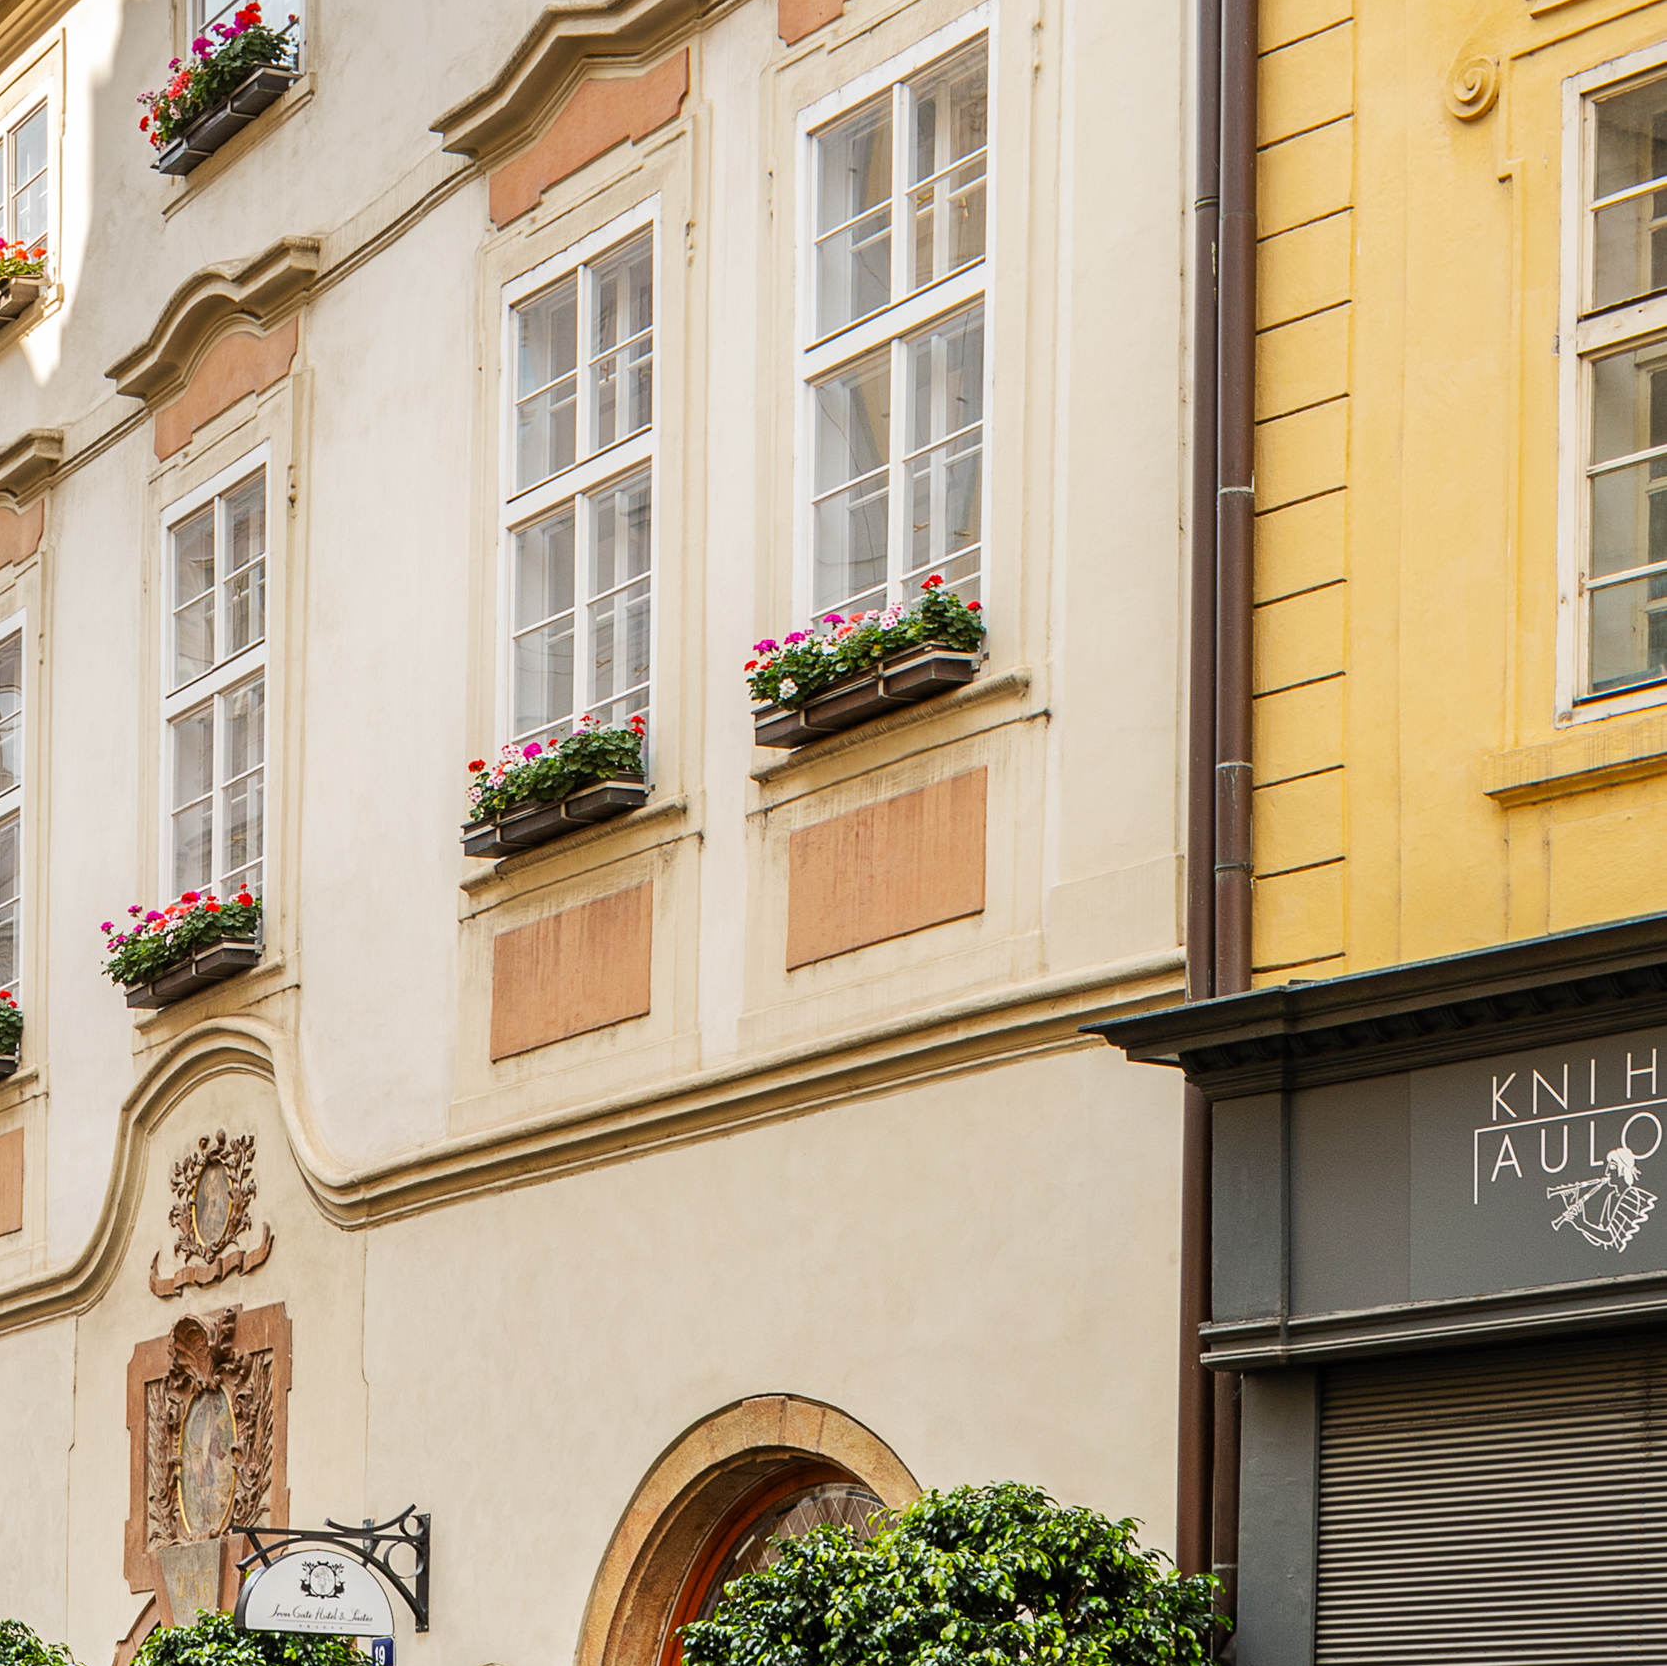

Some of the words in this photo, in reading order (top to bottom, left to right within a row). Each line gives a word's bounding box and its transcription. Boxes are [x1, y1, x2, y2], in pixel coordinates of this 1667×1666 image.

[1491, 1047, 1658, 1121] KNIH
[1490, 1112, 1663, 1183] AULO
[269, 1604, 291, 1618] Iron
[292, 1605, 313, 1619] Gate
[315, 1606, 337, 1621] Hotel
[339, 1611, 346, 1621] &
[346, 1608, 373, 1622] Suites
[374, 1645, 386, 1666] 19
